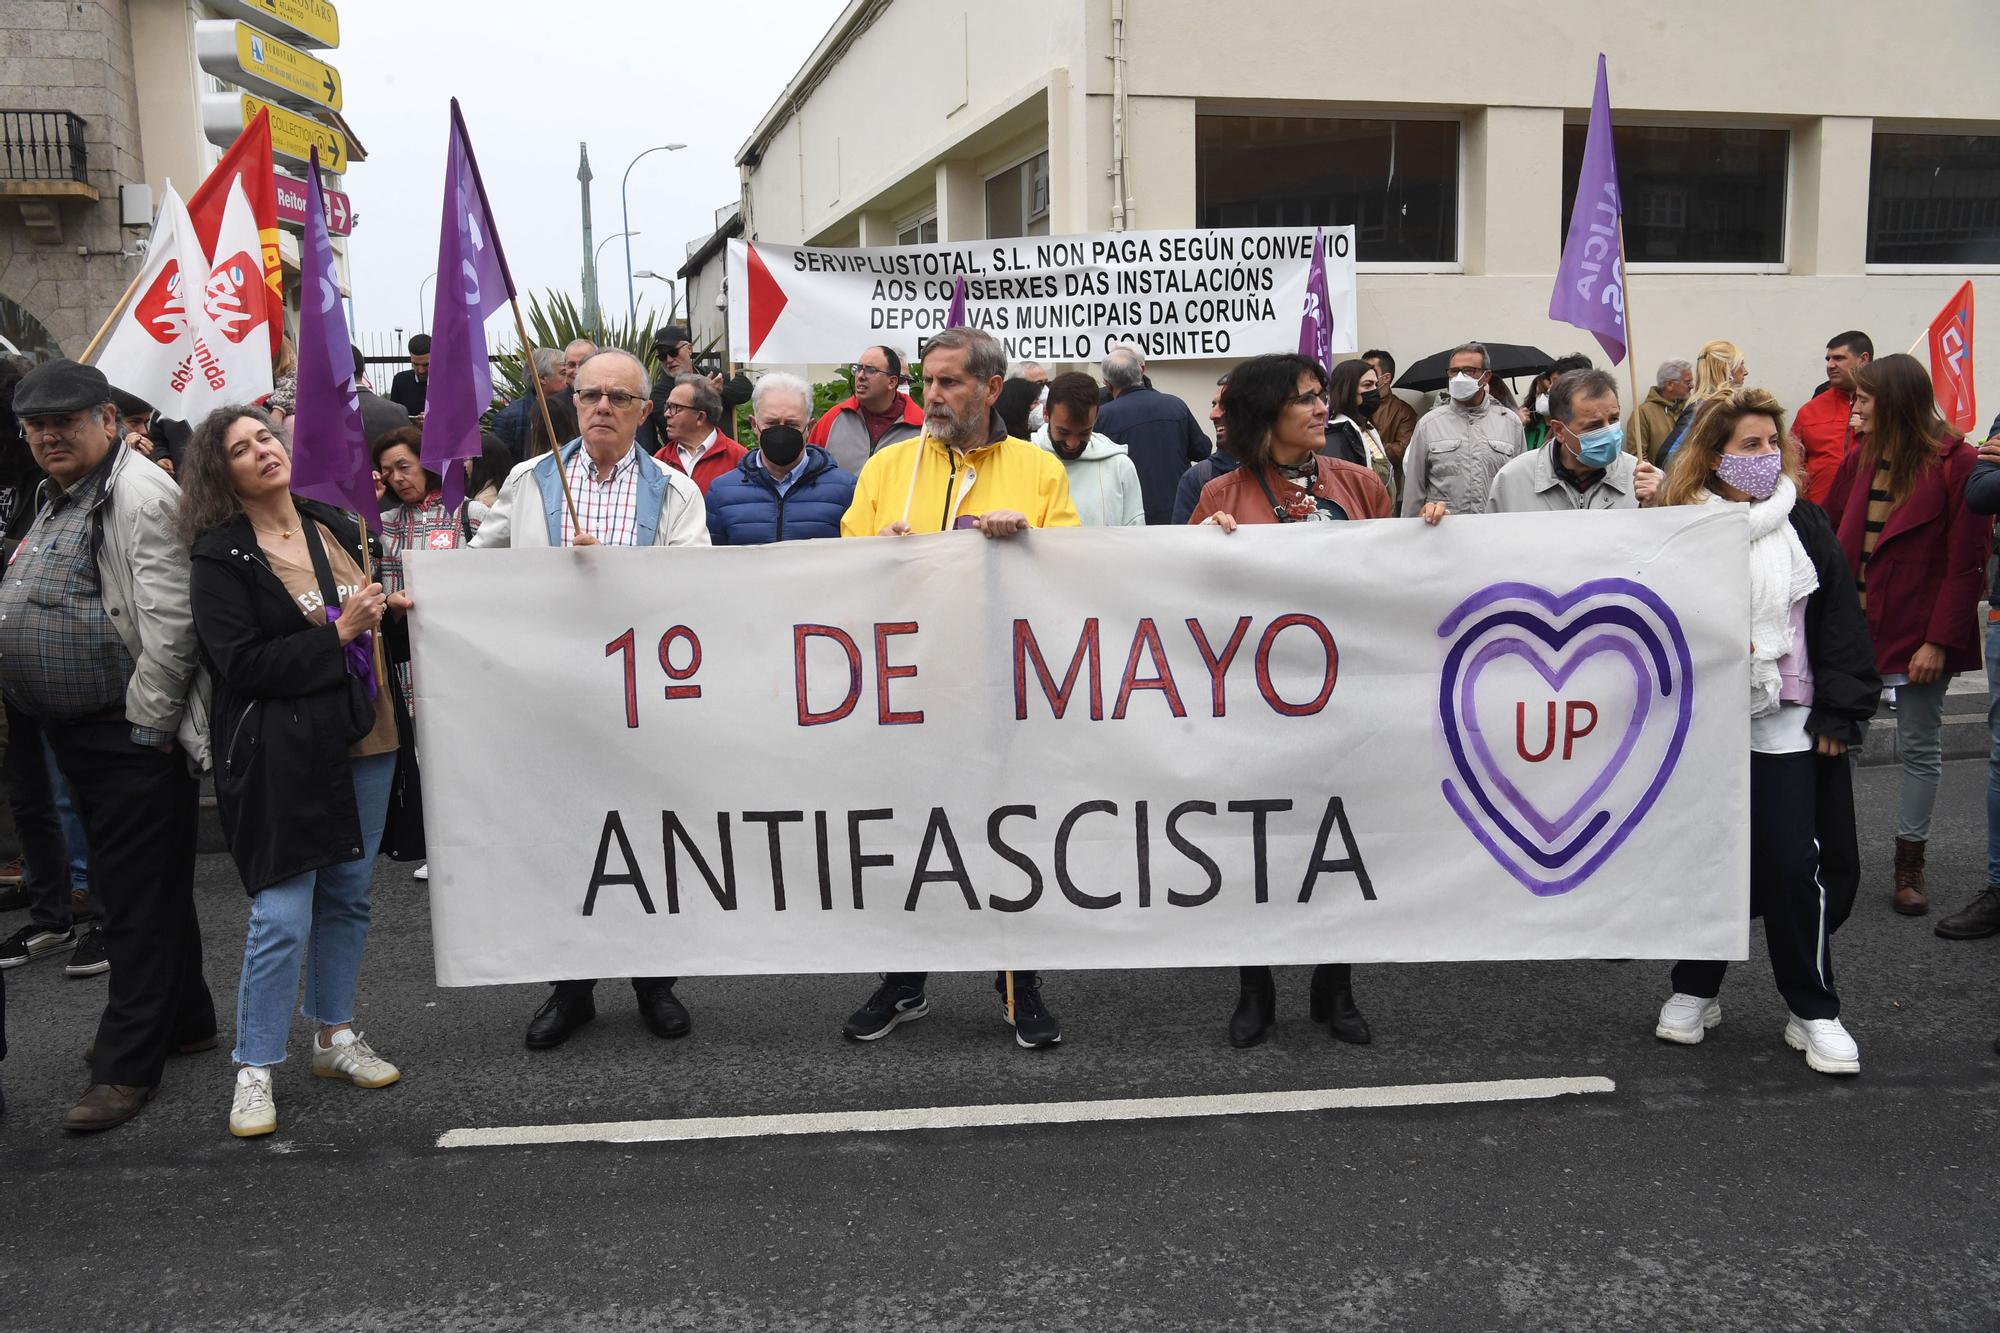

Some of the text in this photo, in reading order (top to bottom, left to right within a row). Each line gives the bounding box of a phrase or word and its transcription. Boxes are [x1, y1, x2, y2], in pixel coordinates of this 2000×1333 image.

[271, 114, 315, 144] COLLECTION
[277, 187, 307, 212] Reitor
[793, 250, 987, 277] SERVIPLUSTOTAL,
[992, 247, 1031, 272] S.L.
[1037, 242, 1084, 269] NON
[1092, 239, 1153, 265] PAGA
[1159, 231, 1234, 262] SEGÚN
[872, 279, 917, 301] AOS
[1065, 271, 1109, 297] DAS
[1117, 261, 1273, 295] INSTALACIÓNS
[871, 293, 1276, 330] DEPORVAS MUNICIPAIS DA CORUÑA
[605, 613, 1339, 728] 1º DE MAYO
[1516, 700, 1599, 763] UP
[582, 796, 1378, 916] ANTIFASCISTA
